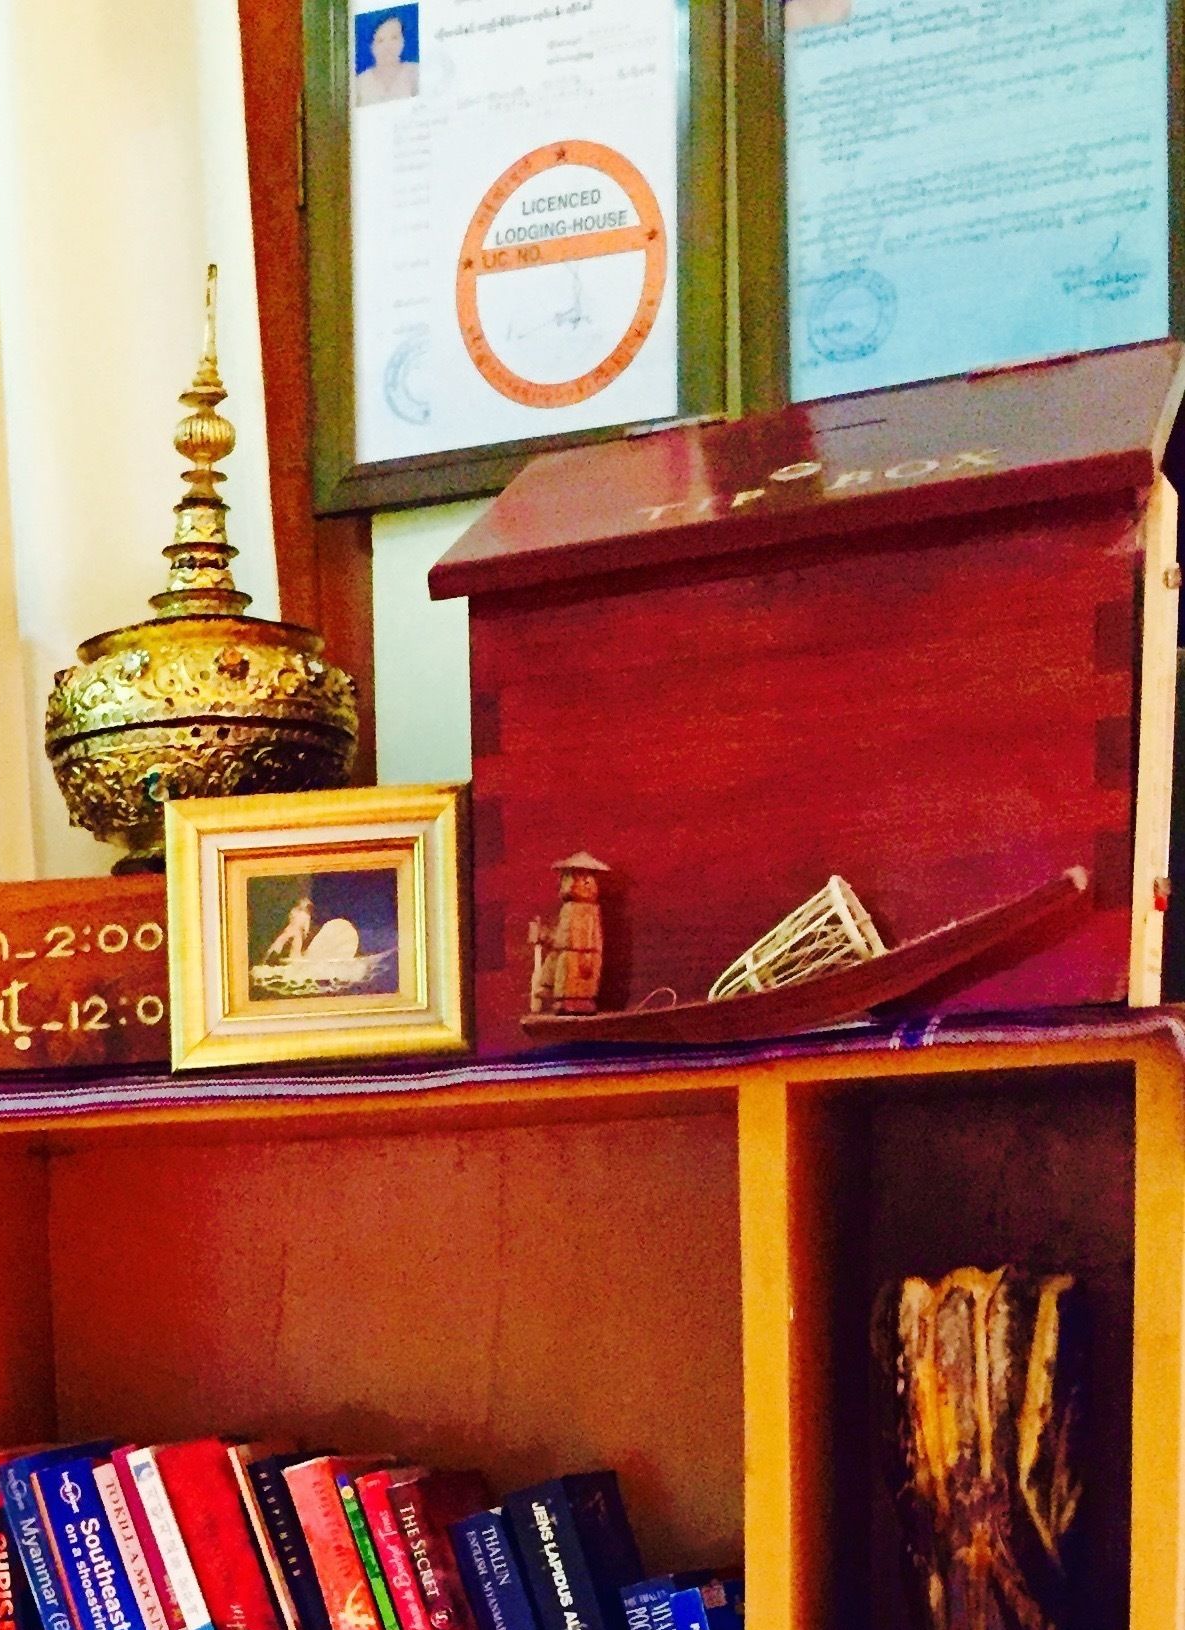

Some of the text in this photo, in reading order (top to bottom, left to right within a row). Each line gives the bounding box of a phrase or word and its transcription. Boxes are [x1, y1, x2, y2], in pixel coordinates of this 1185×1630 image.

[522, 188, 601, 216] LICENCED
[68, 995, 164, 1031] 12:0
[63, 1521, 80, 1544] on
[397, 1502, 423, 1539] THE
[528, 1499, 556, 1542] JENS
[15, 1515, 63, 1609] Myanmar
[70, 1546, 83, 1558] a
[408, 1537, 442, 1600] SECRET
[478, 1523, 515, 1588] THALUN
[539, 1541, 576, 1608] LAPIDUS
